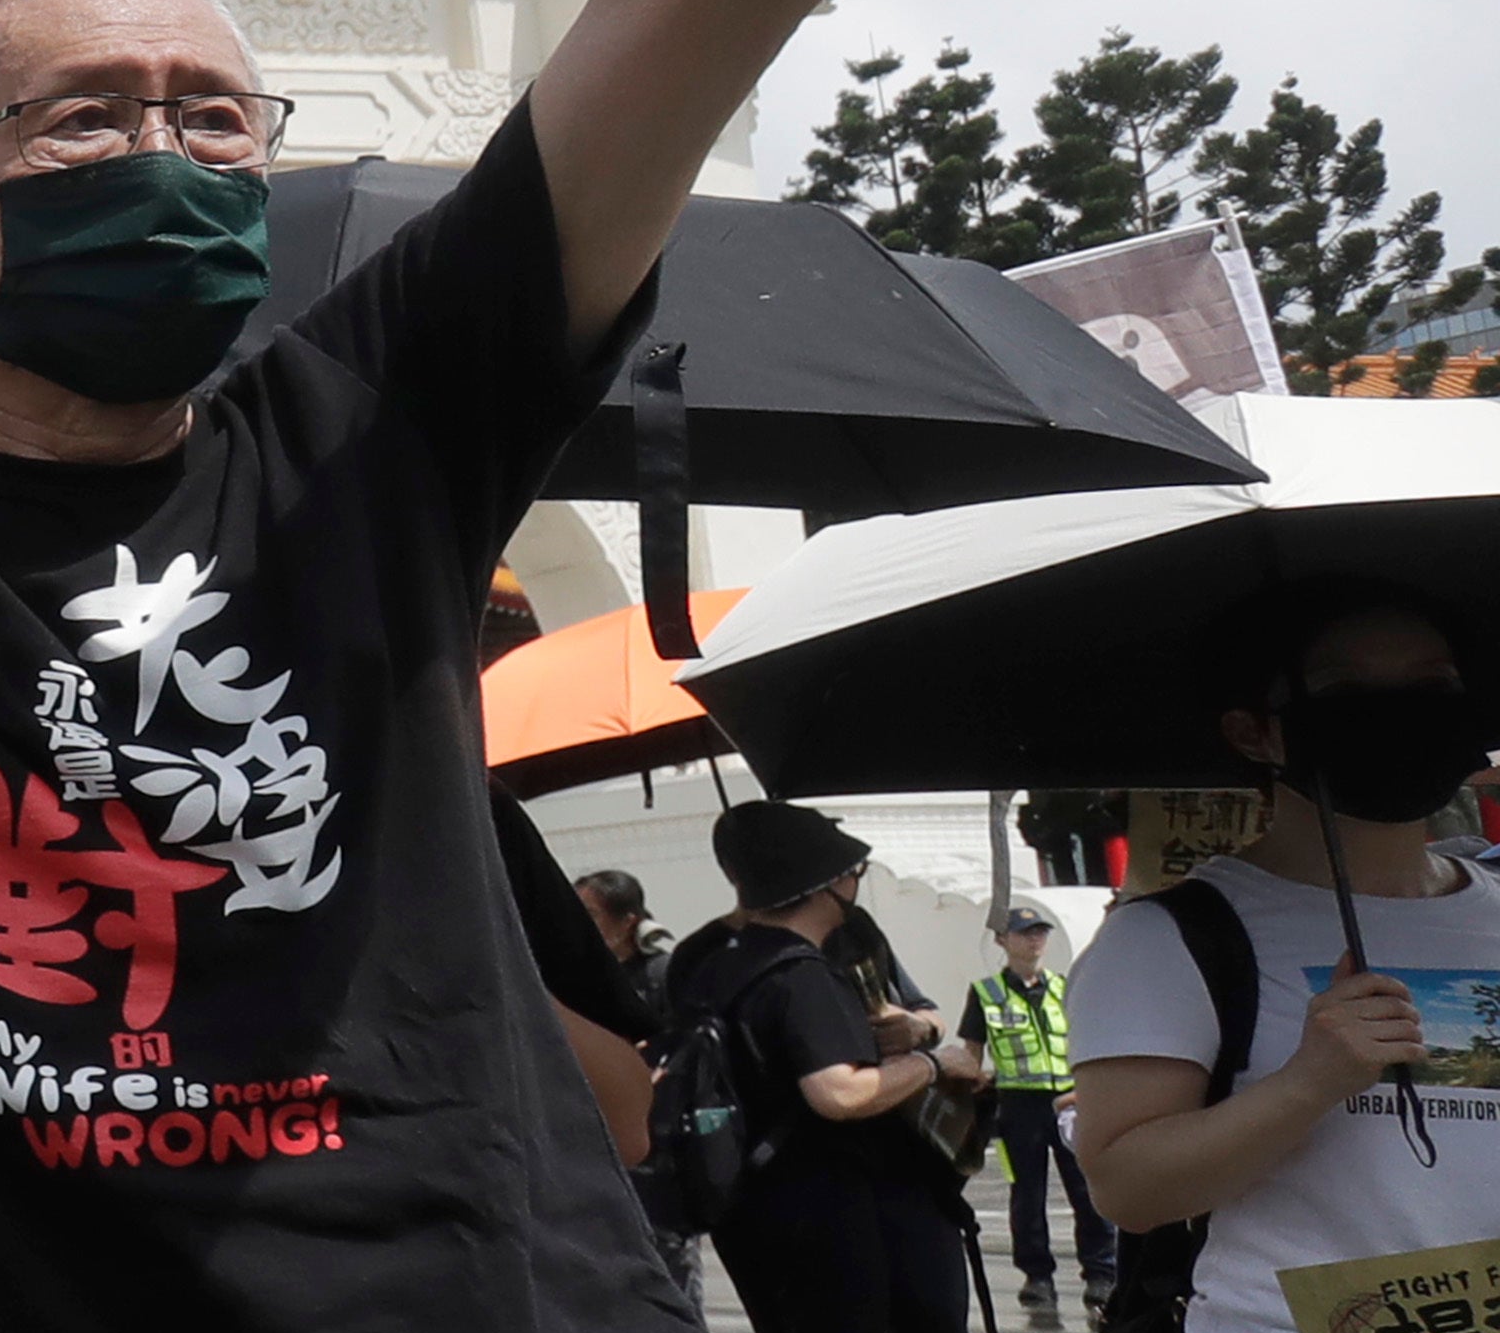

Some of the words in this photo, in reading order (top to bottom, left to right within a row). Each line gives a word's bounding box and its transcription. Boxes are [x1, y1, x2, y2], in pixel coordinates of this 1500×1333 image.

[110, 1031, 173, 1070] 的
[173, 1074, 210, 1110] is
[212, 1072, 329, 1106] never
[22, 1102, 344, 1170] WRONG!
[1380, 1270, 1470, 1300] FIGHT
